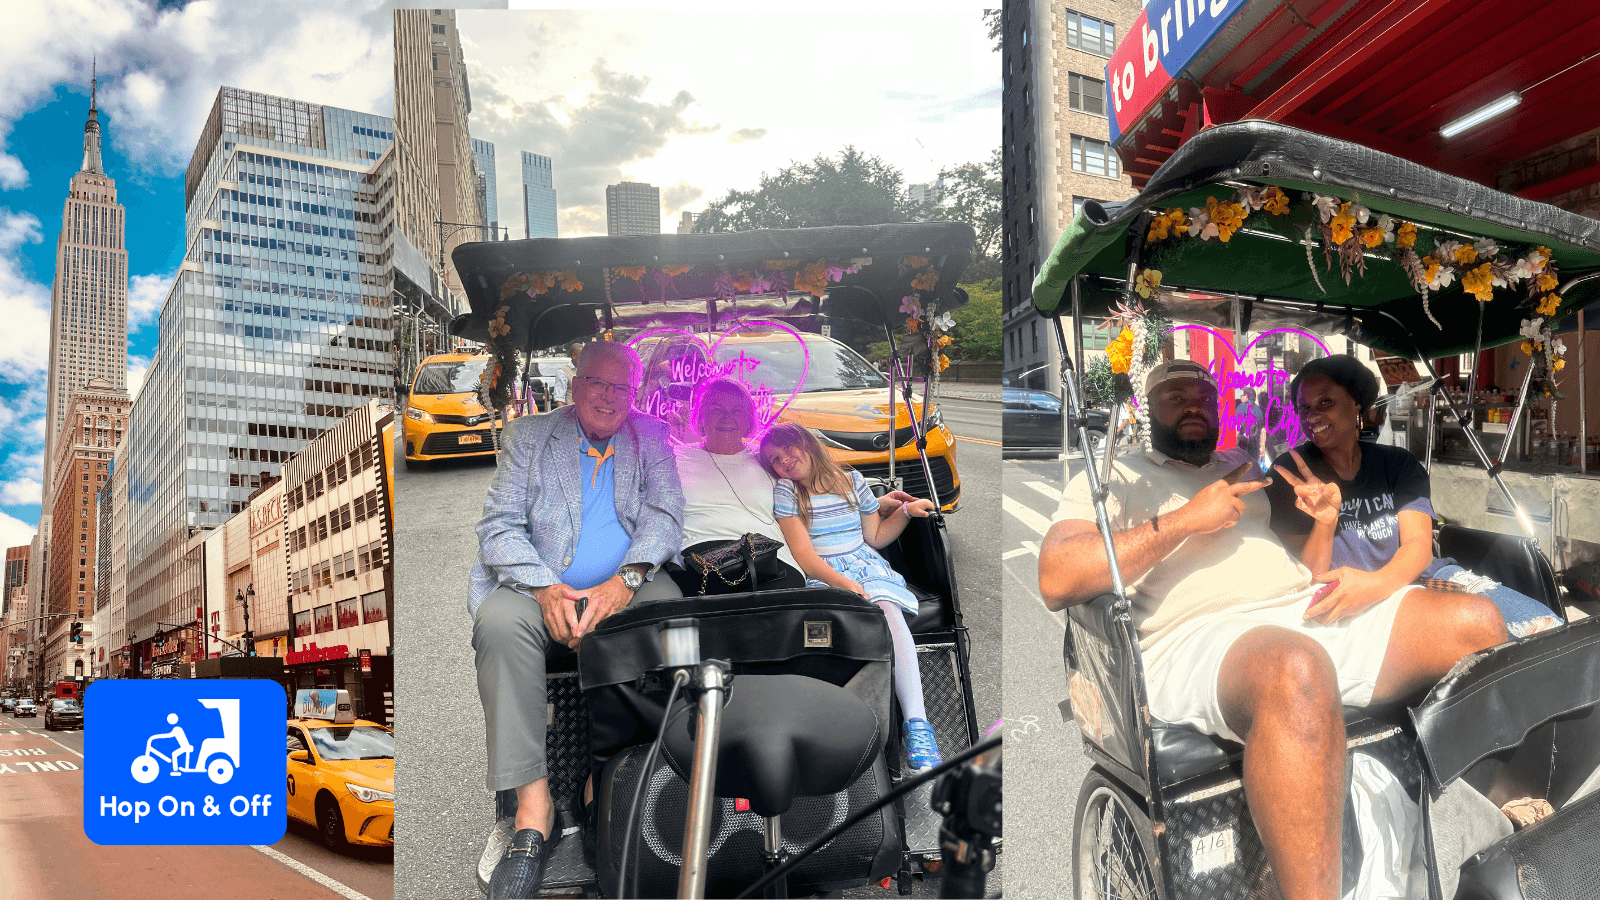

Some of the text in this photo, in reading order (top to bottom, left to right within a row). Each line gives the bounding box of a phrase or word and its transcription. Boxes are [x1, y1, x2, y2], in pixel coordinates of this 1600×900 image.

[1112, 61, 1135, 113] to
[671, 349, 762, 385] Welcome to
[1262, 360, 1291, 398] to
[645, 389, 684, 419] New
[1265, 396, 1300, 447] City
[1344, 520, 1362, 530] HAVE
[1367, 526, 1393, 540] COUCH
[0, 760, 80, 775] ONLY
